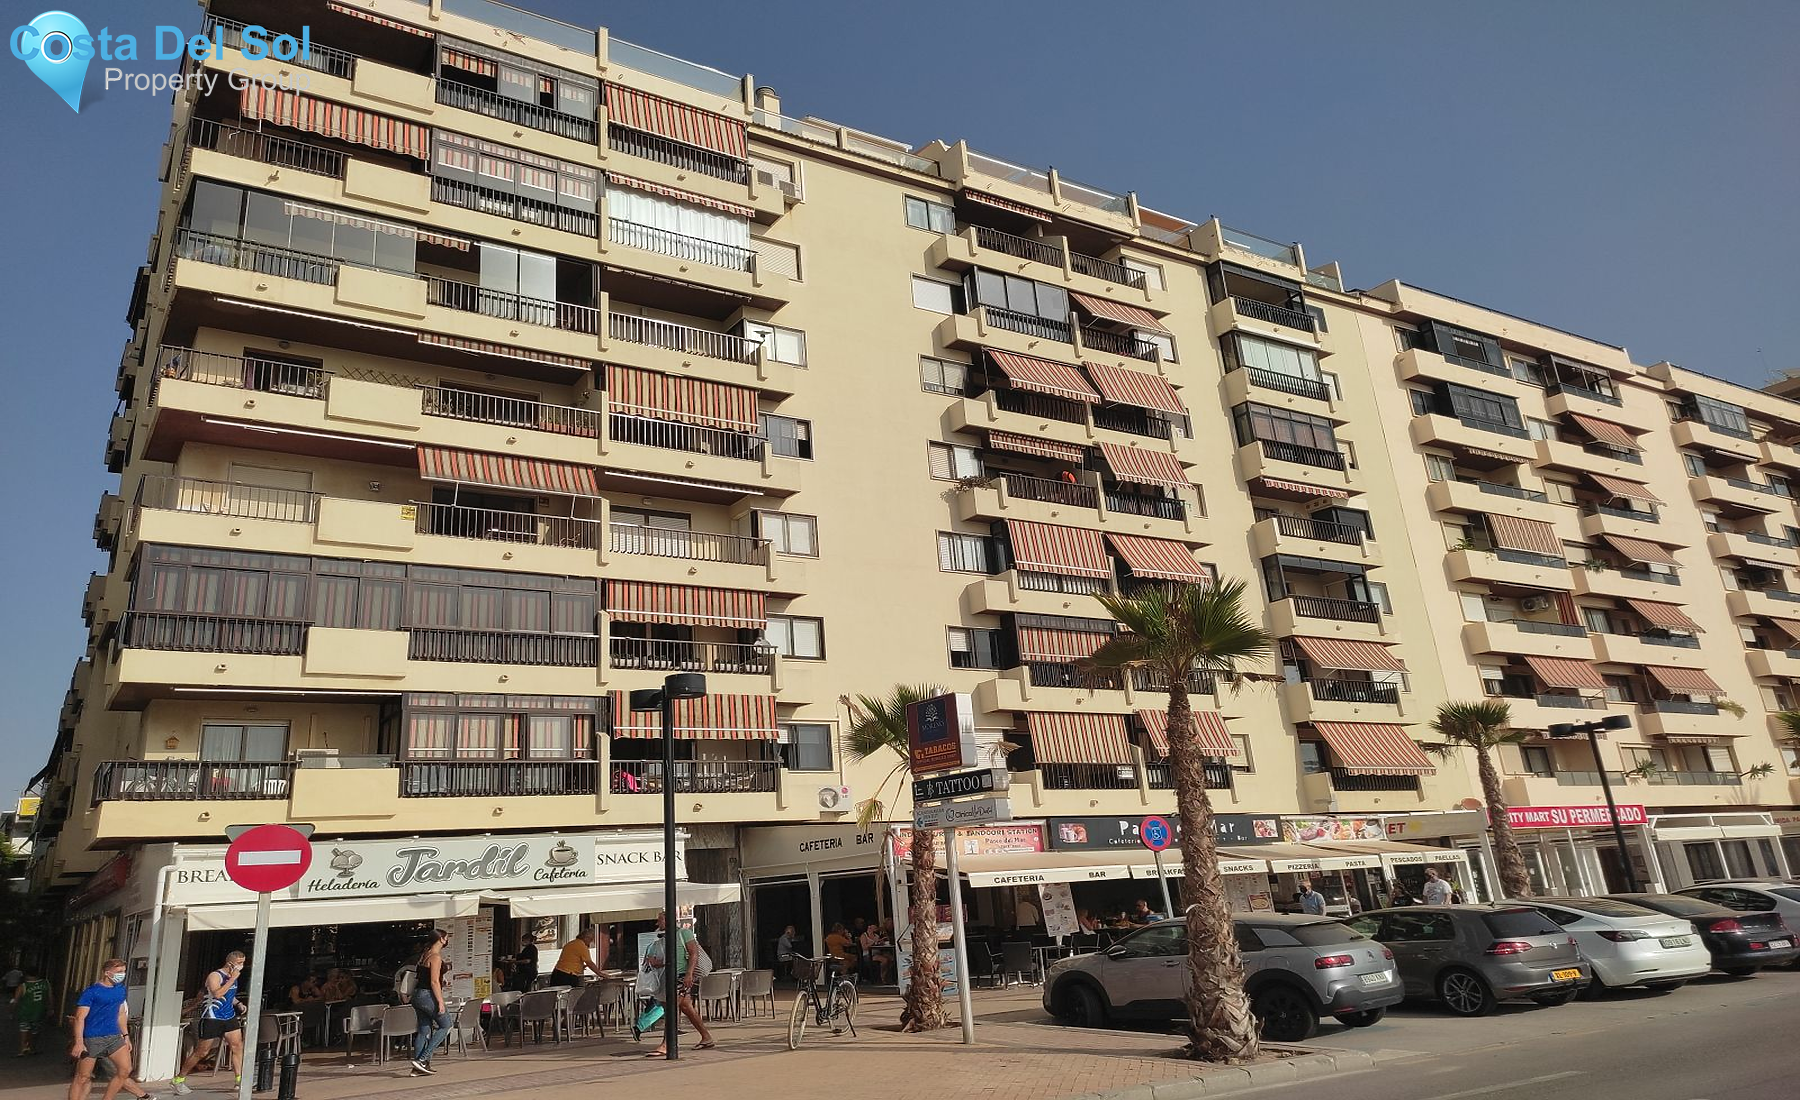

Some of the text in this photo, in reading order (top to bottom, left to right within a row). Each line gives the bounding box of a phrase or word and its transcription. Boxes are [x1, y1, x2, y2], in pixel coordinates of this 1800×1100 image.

[924, 742, 956, 754] TABACOS
[936, 775, 980, 795] TATTOO
[1506, 812, 1524, 823] ITY
[1525, 811, 1550, 823] MART
[1551, 808, 1568, 824] SU
[1007, 828, 1038, 836] STATION
[1385, 822, 1406, 835] ET
[799, 832, 874, 853] CAFETERIA BAR
[597, 850, 683, 866] SNACK BR
[1389, 856, 1423, 864] PESCADOS
[1434, 854, 1461, 862] PAELLAS
[1223, 864, 1254, 873] SNACKS
[1287, 862, 1320, 871] PIZZERIA
[1345, 860, 1367, 868] PASTA
[993, 874, 1045, 884] CAFETERIA
[1088, 871, 1107, 879] BAR
[308, 878, 381, 893] Heladería
